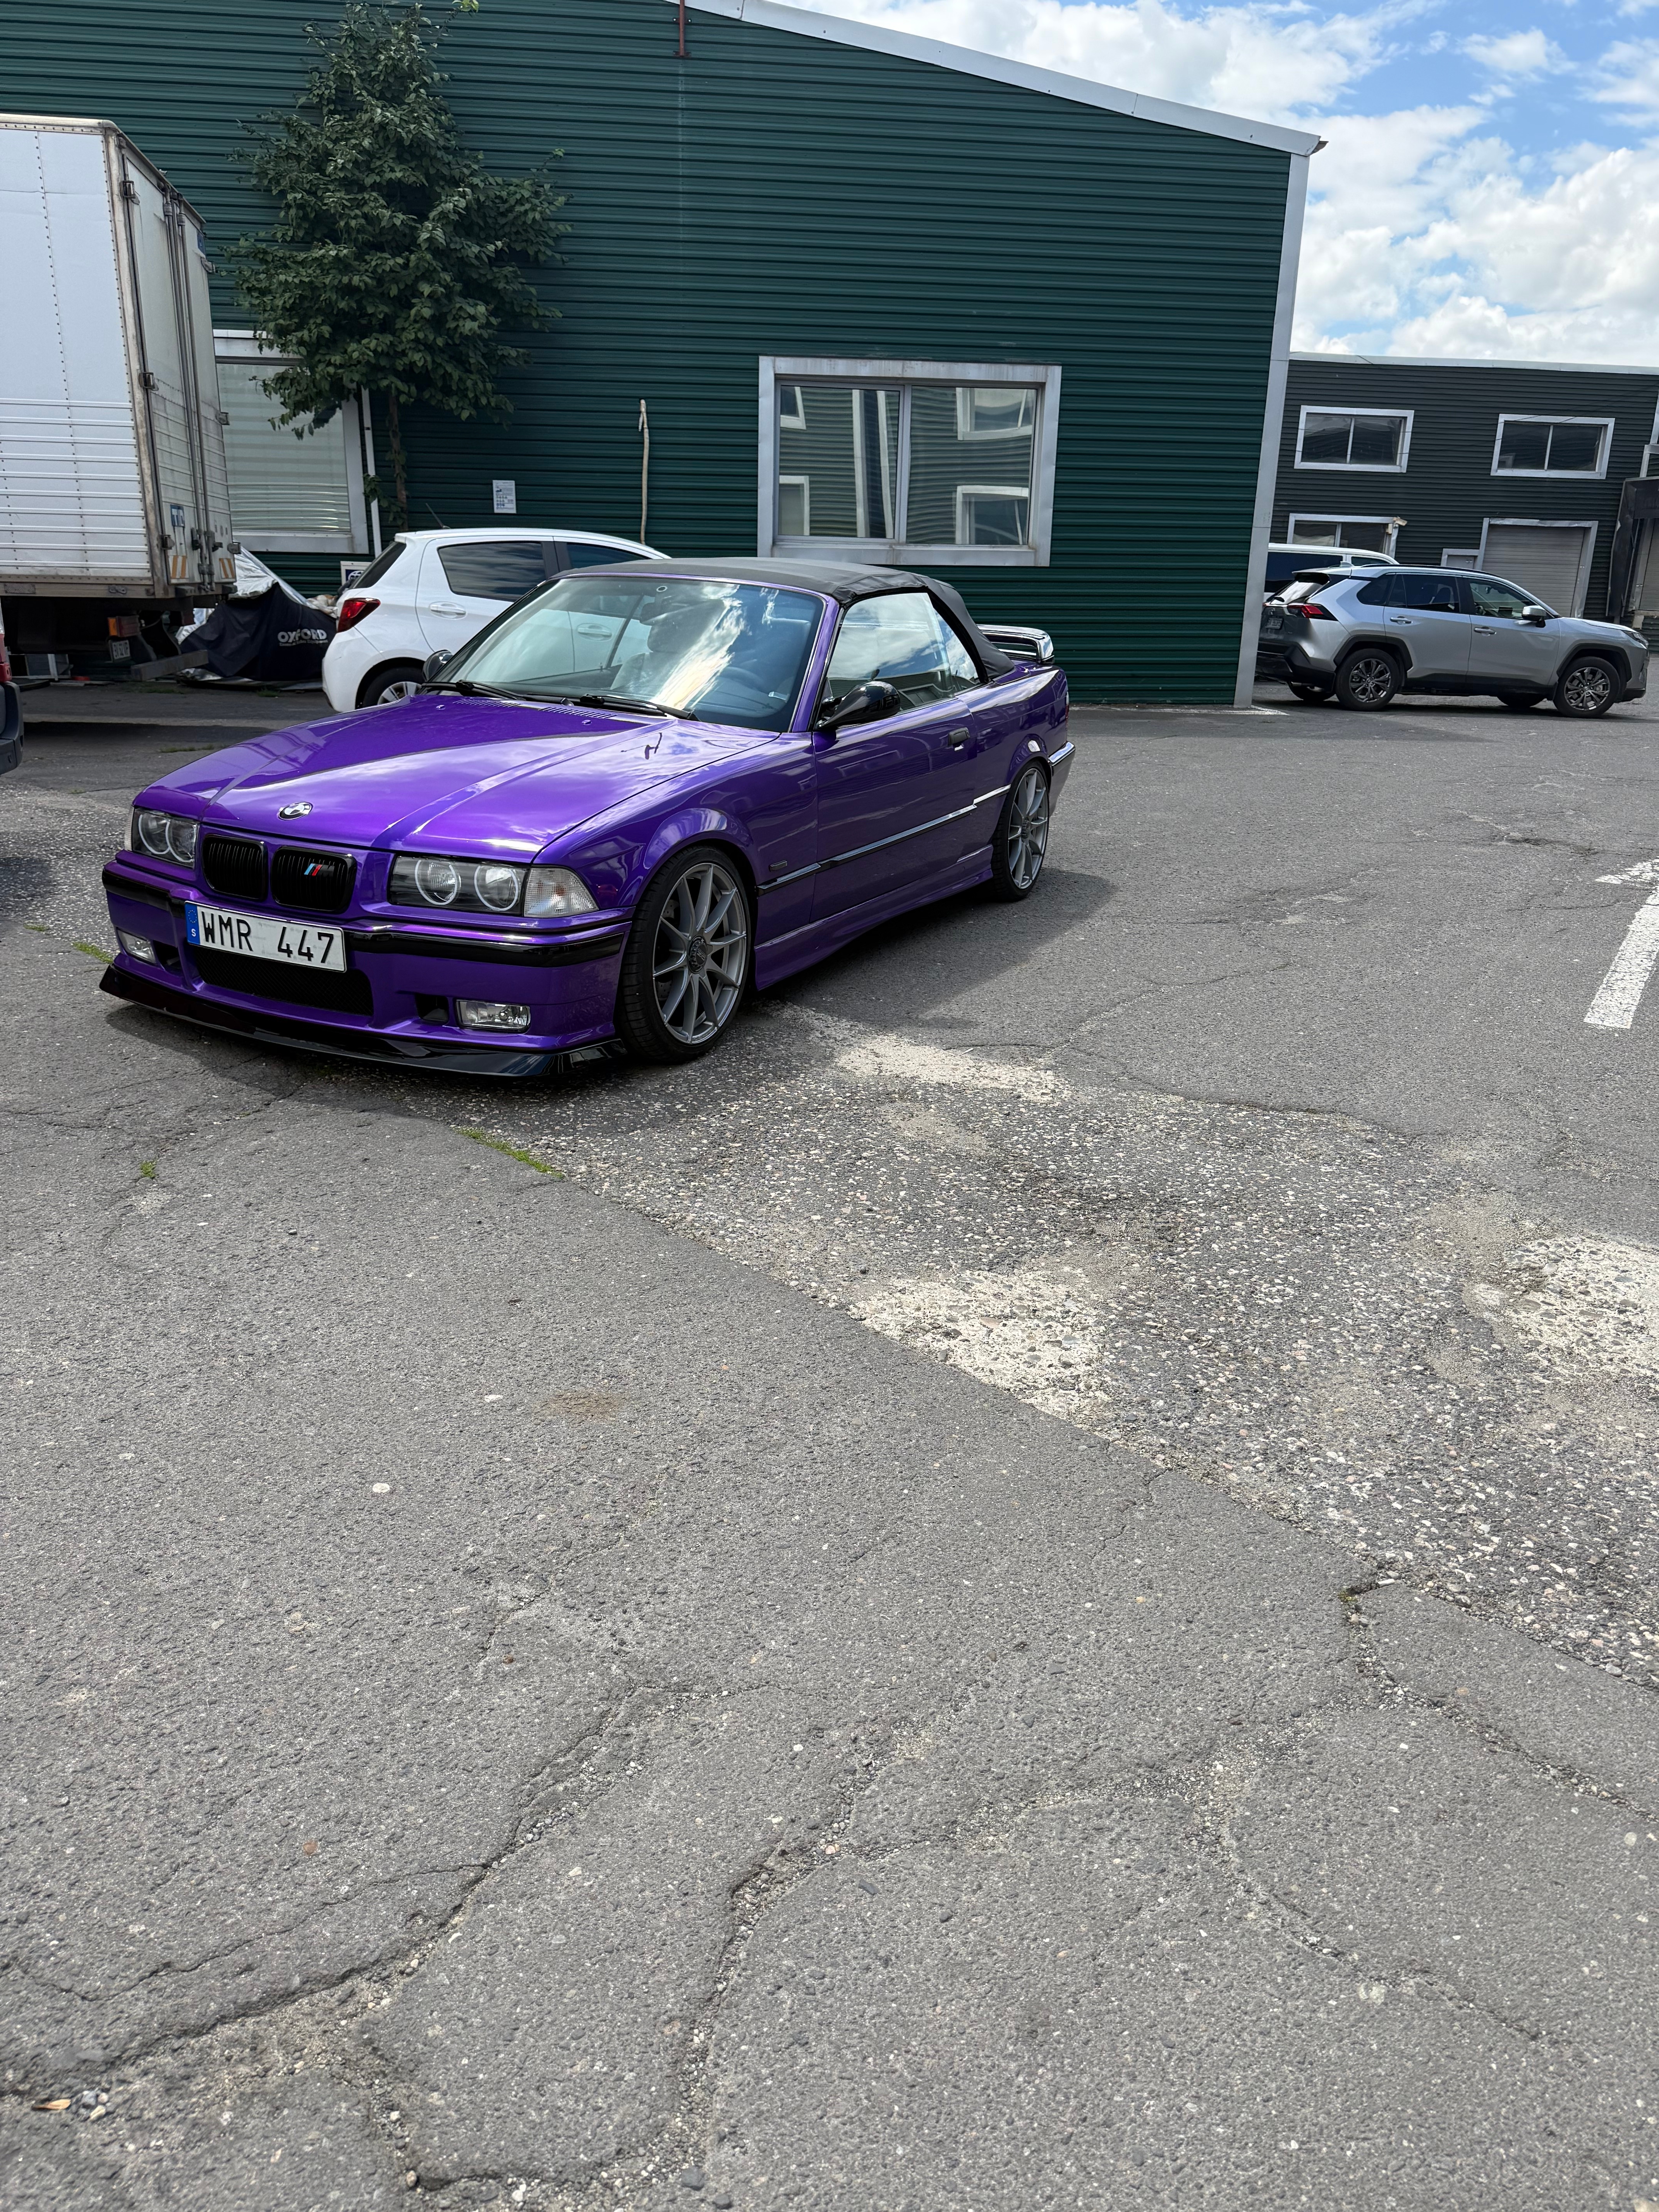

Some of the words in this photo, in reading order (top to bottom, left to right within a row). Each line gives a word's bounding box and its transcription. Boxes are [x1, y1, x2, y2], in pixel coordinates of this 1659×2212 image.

[278, 629, 327, 642] OXFORD
[191, 928, 196, 937] S
[201, 911, 253, 951] WMR
[278, 926, 334, 963] 447
